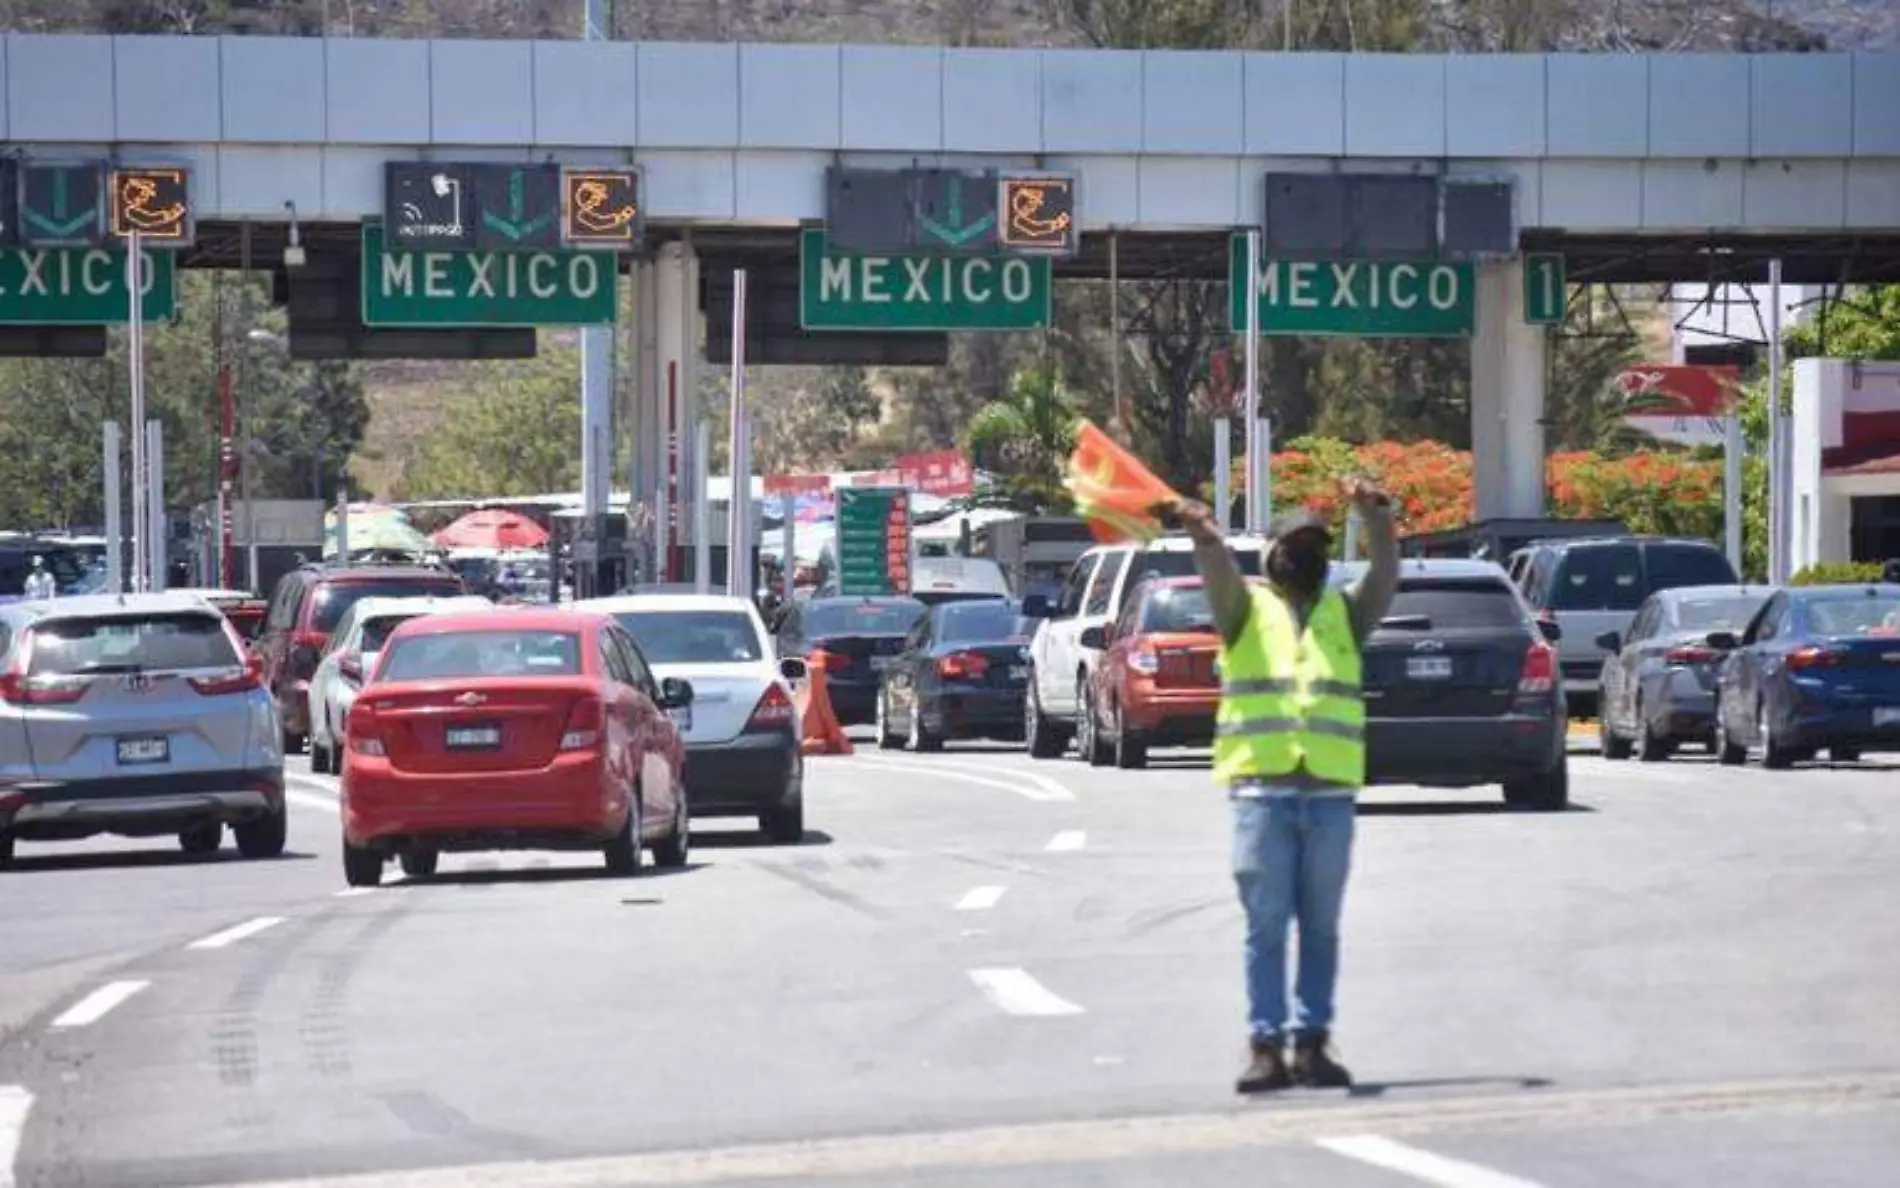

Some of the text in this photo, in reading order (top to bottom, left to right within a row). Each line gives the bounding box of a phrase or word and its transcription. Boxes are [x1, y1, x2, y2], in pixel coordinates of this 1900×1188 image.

[0, 250, 155, 295] XICO
[381, 252, 598, 298] MEXICO
[820, 257, 1031, 303] MEXICO
[1256, 262, 1459, 309] MEXICO
[1538, 262, 1553, 316] 1
